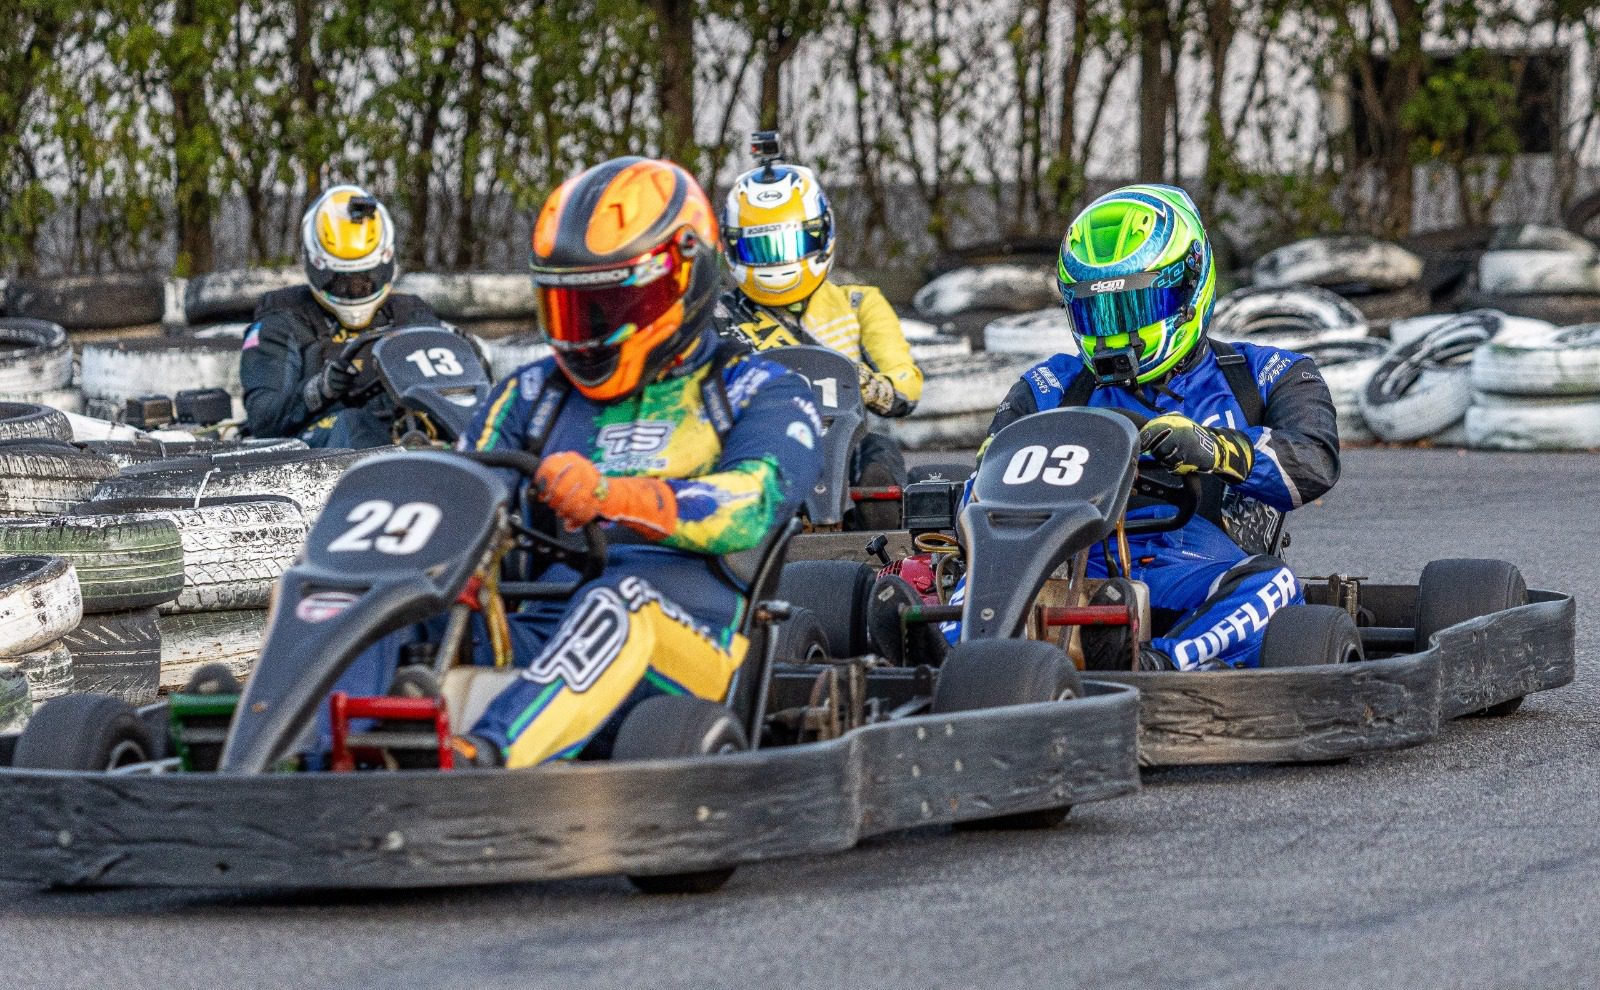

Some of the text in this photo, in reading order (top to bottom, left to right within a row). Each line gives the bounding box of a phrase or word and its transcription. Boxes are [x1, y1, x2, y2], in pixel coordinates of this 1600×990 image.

[405, 347, 464, 377] 13
[602, 424, 670, 456] TS
[1002, 444, 1090, 486] 03
[327, 500, 443, 555] 29
[1174, 567, 1296, 672] COFFLER
